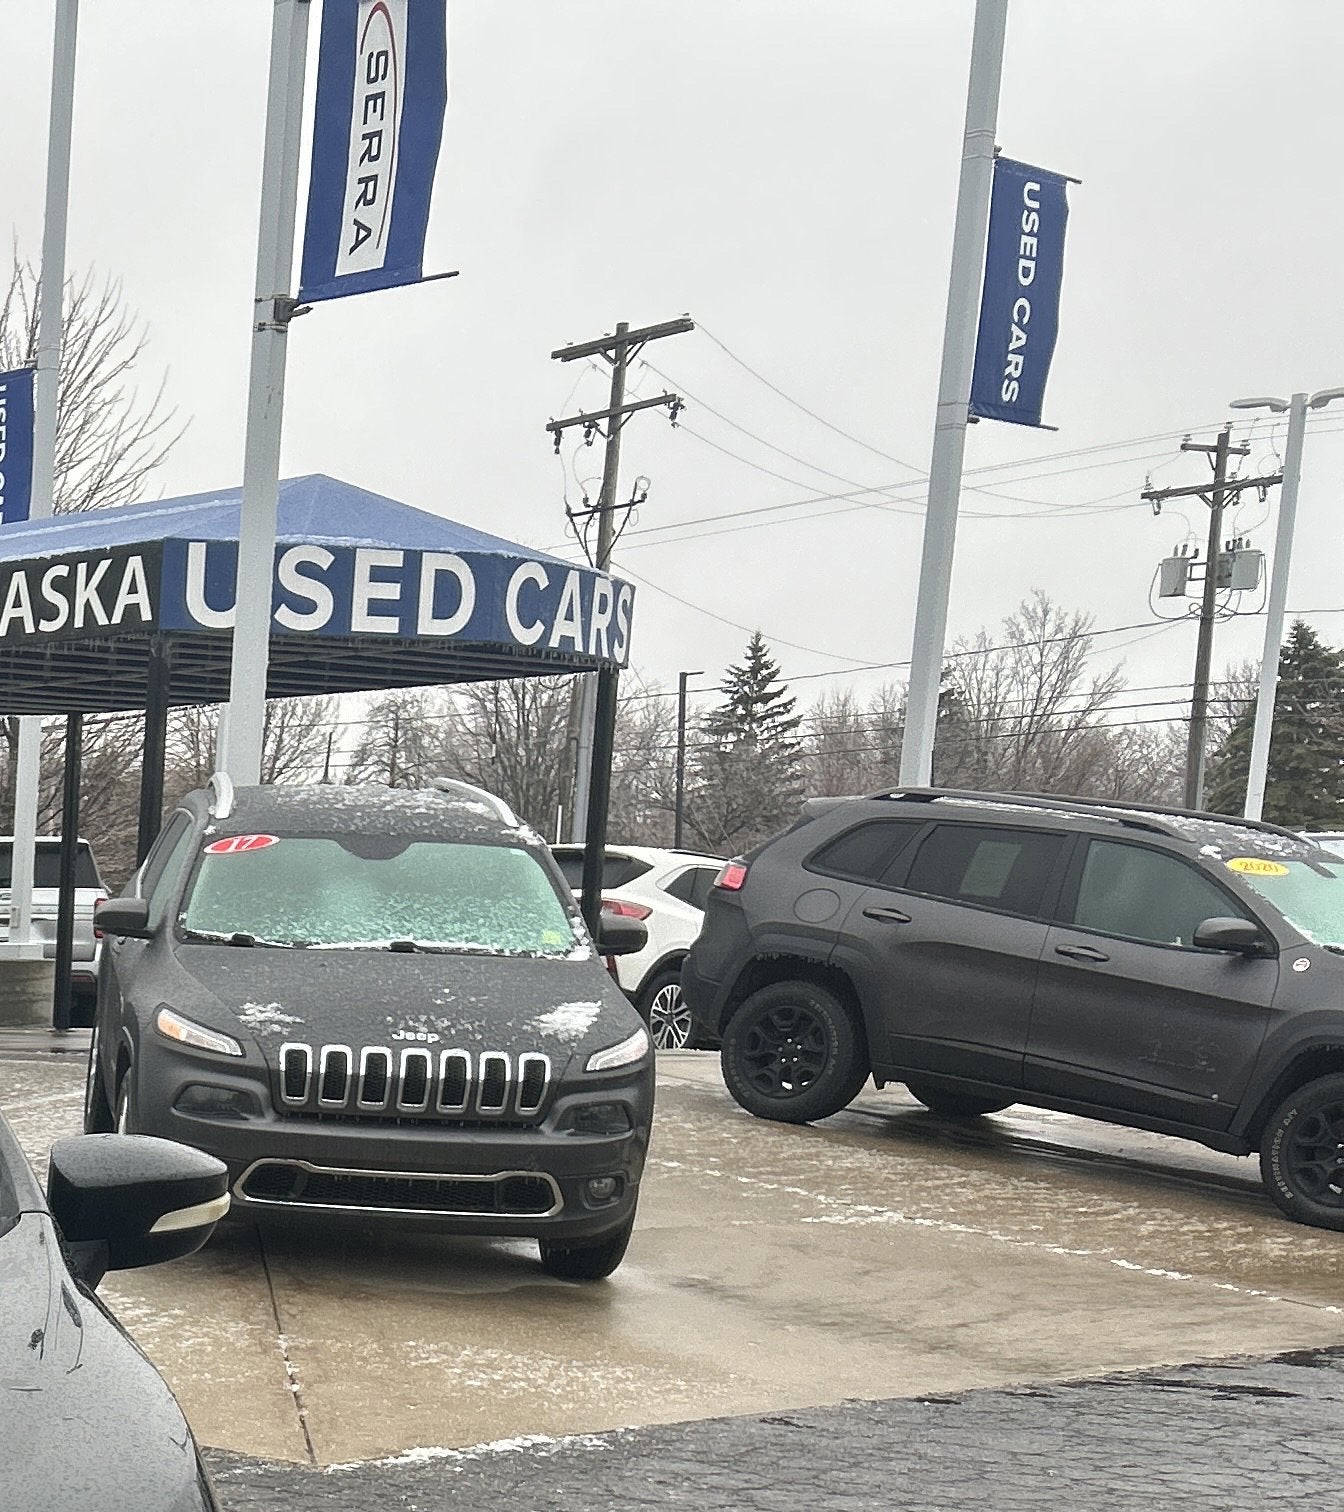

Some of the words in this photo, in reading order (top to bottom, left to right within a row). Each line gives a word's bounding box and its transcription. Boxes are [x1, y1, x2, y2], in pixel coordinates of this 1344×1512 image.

[349, 49, 389, 256] SERRA
[1016, 181, 1041, 287] USED
[1000, 297, 1032, 404] CARS
[185, 541, 477, 636] USED
[505, 561, 632, 665] CARS
[391, 1030, 440, 1044] Jeep
